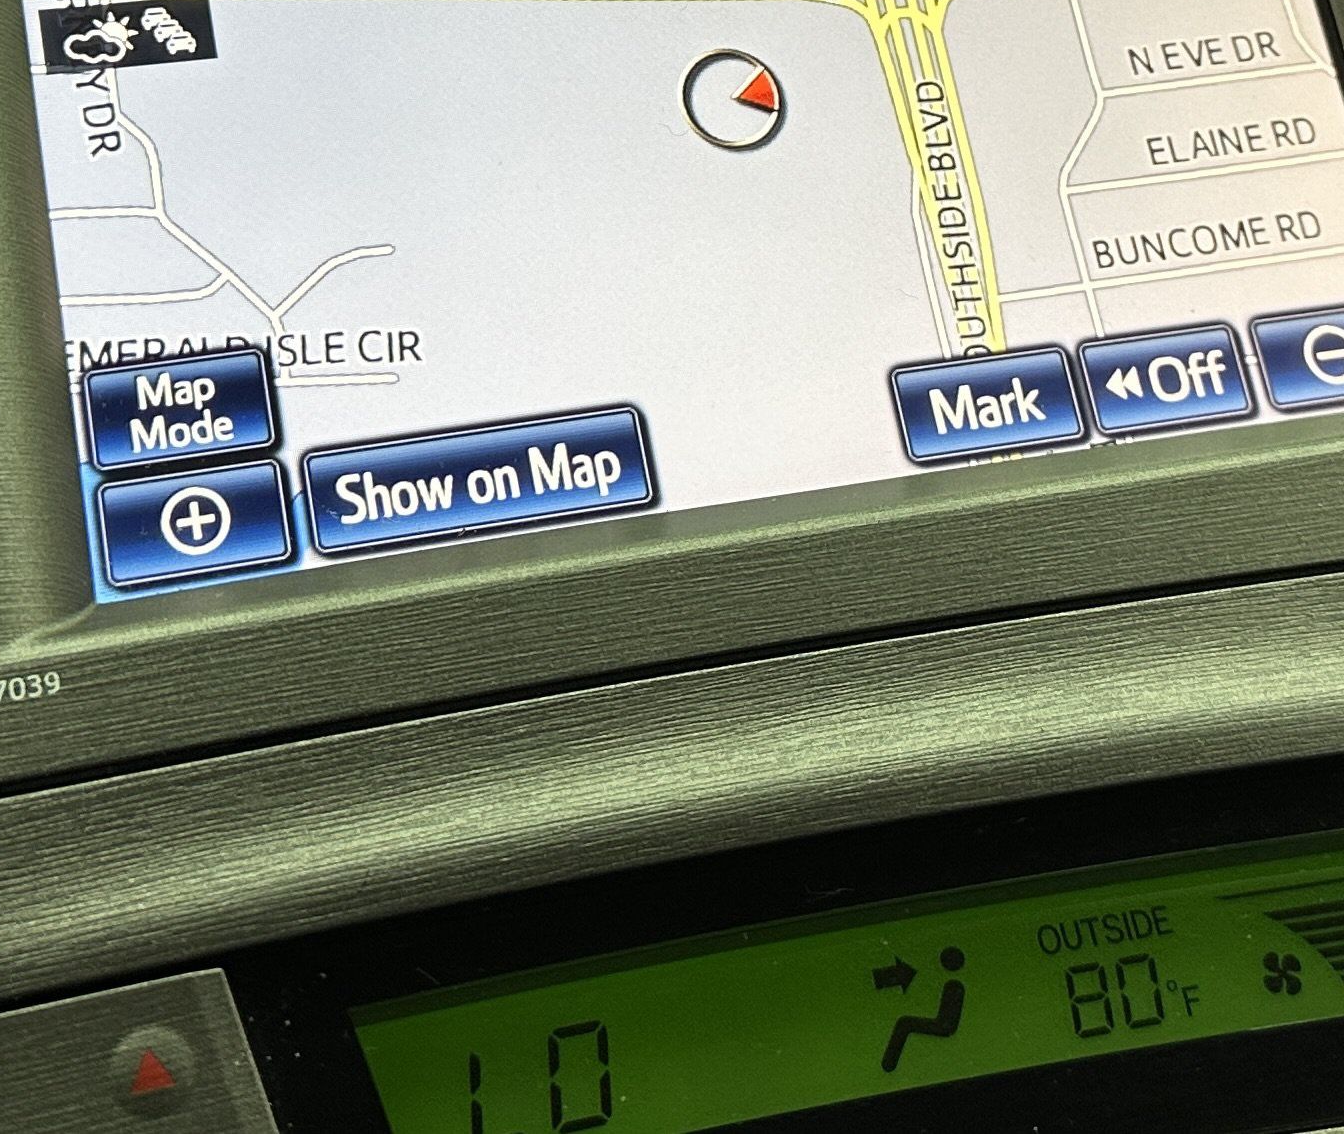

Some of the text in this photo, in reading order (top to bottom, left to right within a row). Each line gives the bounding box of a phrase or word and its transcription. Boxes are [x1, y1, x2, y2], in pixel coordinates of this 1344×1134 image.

[1127, 30, 1281, 77] N EVE DR
[82, 102, 122, 158] DR
[915, 79, 957, 171] BLVD
[1146, 116, 1317, 167] ELAINE RD
[1091, 210, 1322, 270] BUNCOME RD
[265, 329, 344, 368] ISLE
[356, 329, 423, 364] CIR
[136, 372, 216, 413] Map
[1149, 348, 1227, 403] Off
[129, 410, 236, 454] Mode
[928, 377, 1047, 436] Mark
[336, 441, 622, 526] Show on Map
[1036, 904, 1174, 956] OUTSIDE
